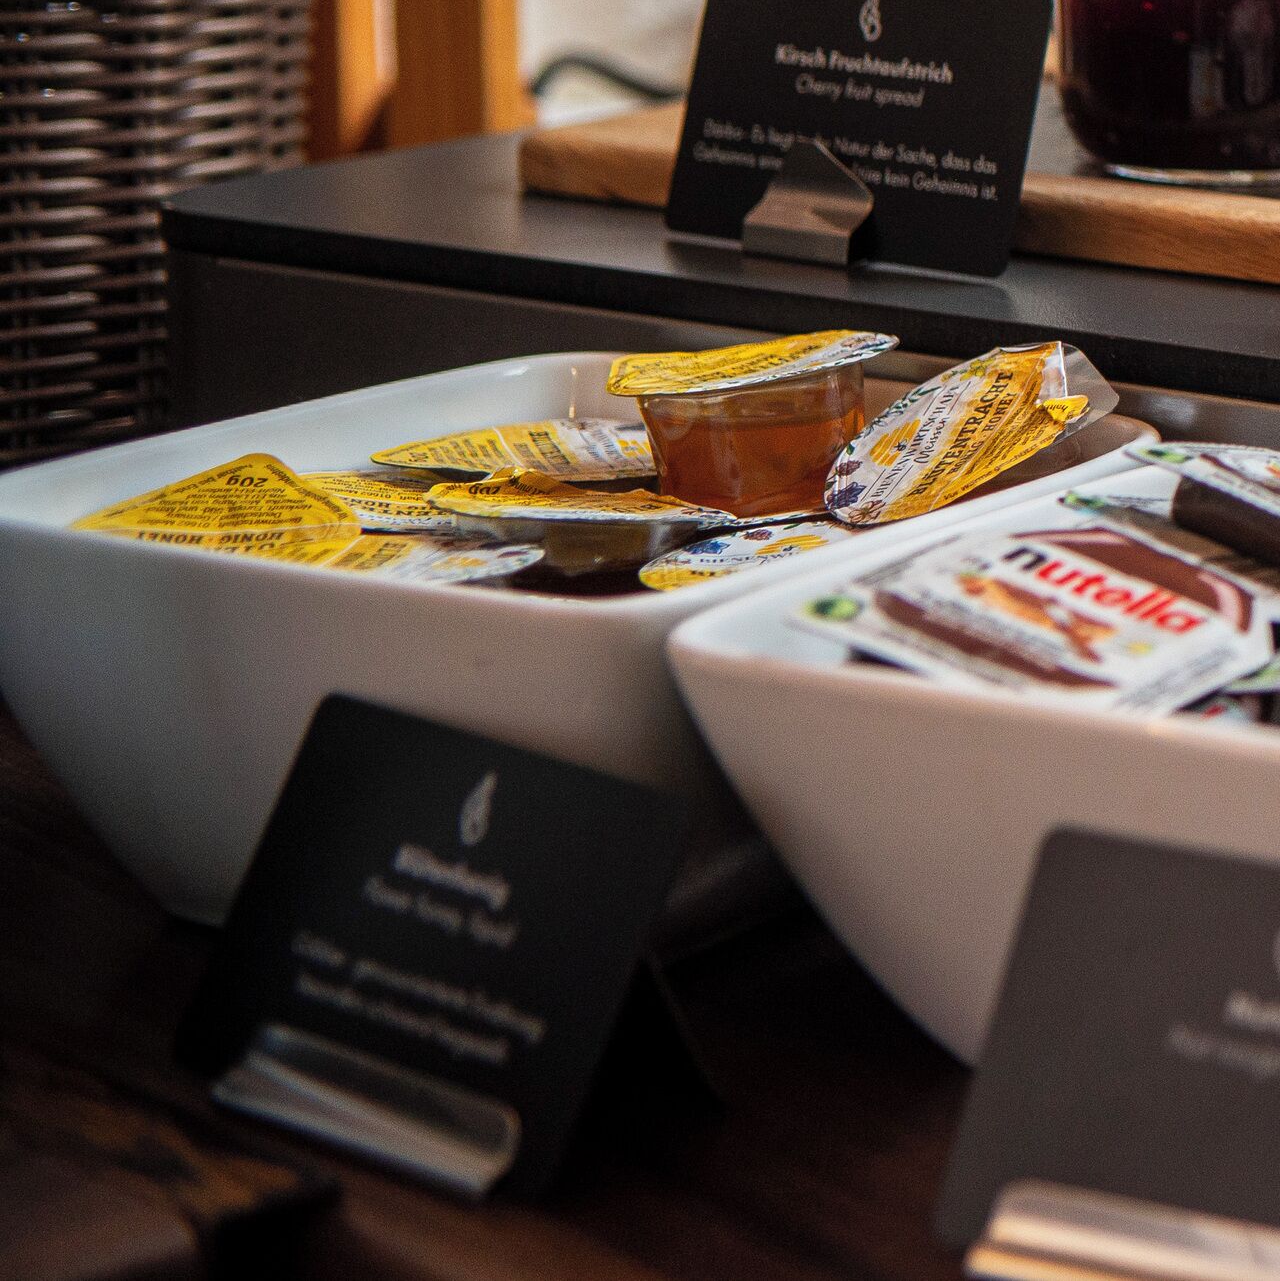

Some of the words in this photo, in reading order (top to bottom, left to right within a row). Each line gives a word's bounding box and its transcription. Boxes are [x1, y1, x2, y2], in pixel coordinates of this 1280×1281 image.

[829, 49, 954, 84] Fruchtaufstrich
[795, 72, 843, 102] Cherry
[844, 77, 873, 100] fruit
[872, 86, 926, 109] spread
[941, 150, 971, 172] dass
[973, 153, 998, 175] das
[912, 170, 979, 199] Geheimnis
[909, 371, 1014, 497] BLÜTENTRACHT
[914, 417, 948, 464] Meissen
[950, 439, 984, 474] HONIG
[981, 392, 1017, 432] HONEY
[225, 474, 268, 489] 20g
[136, 529, 205, 545] HONEY
[218, 531, 285, 544] HONIG
[1003, 546, 1202, 635] nutella
